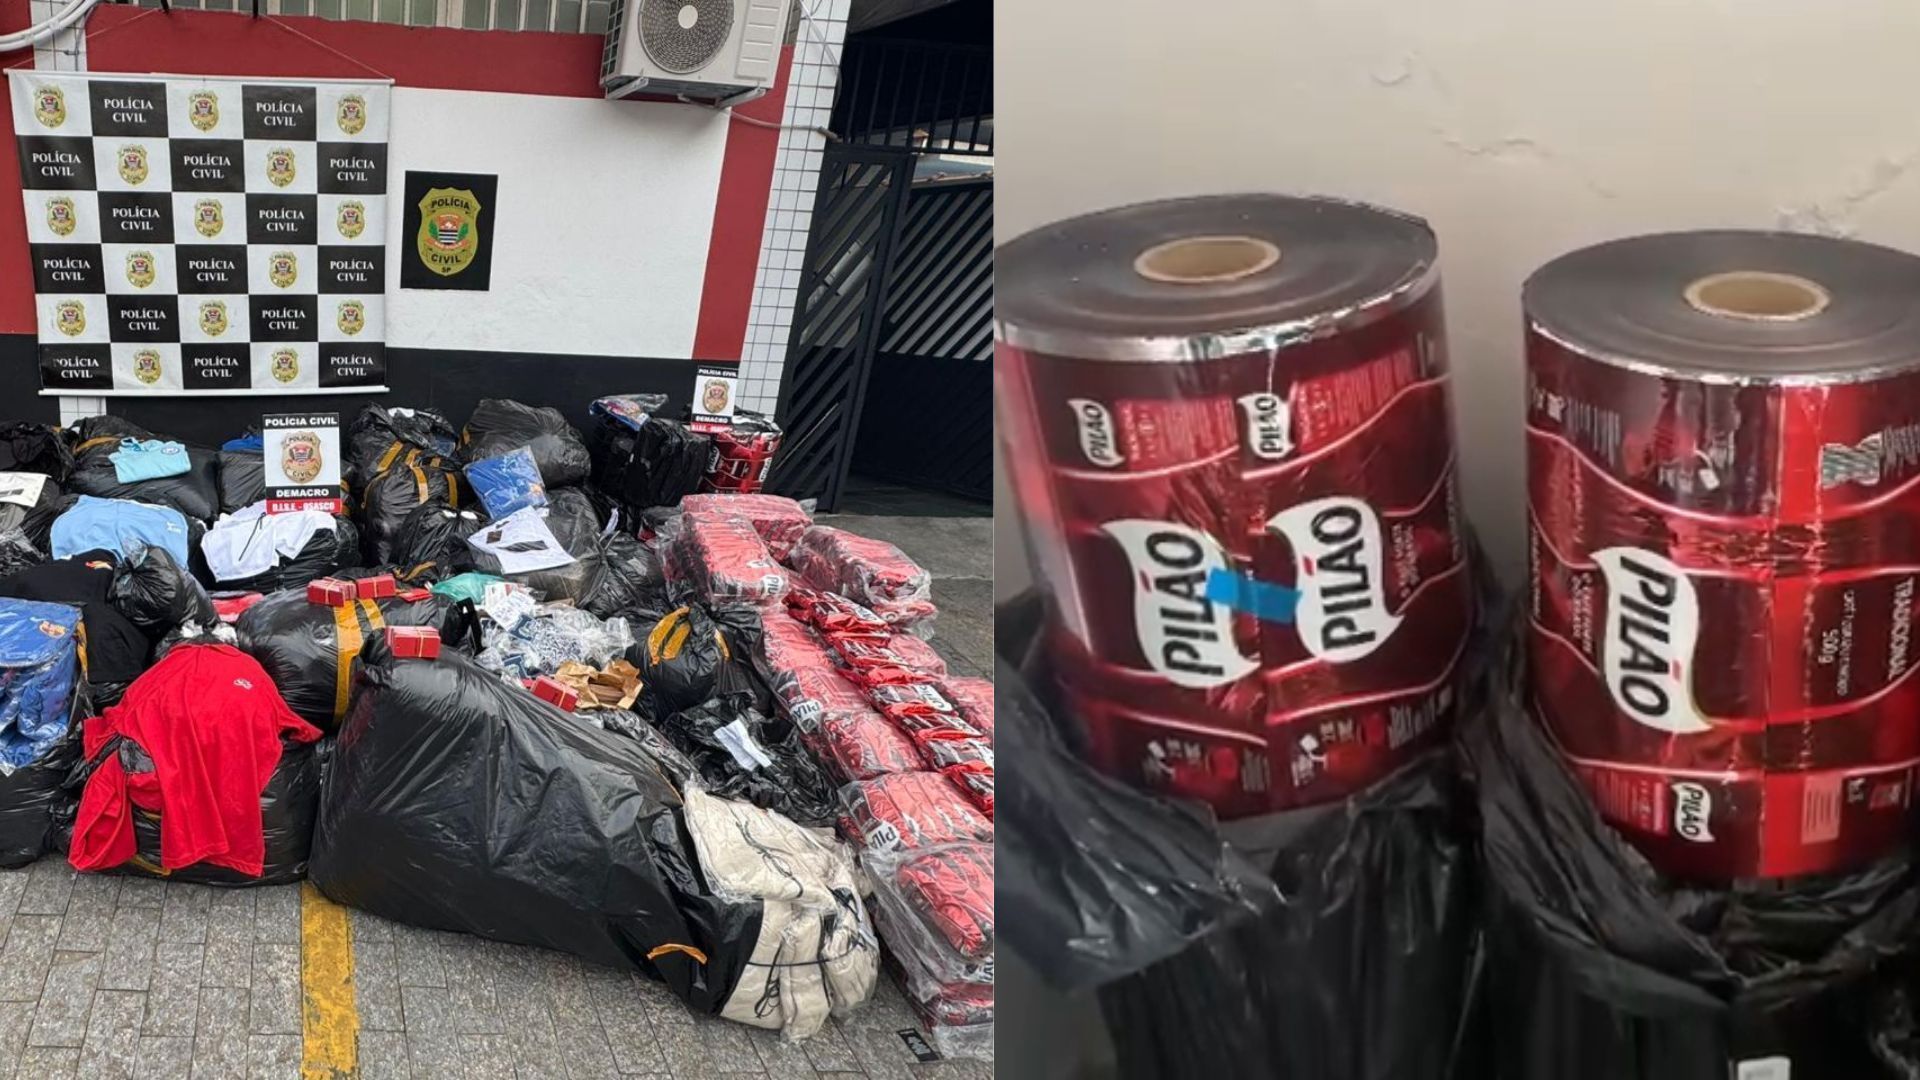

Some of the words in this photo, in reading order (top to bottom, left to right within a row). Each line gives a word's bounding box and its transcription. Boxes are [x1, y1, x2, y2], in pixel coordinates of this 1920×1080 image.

[104, 97, 154, 110] POLÍCIA
[256, 102, 303, 113] POLÍCIA
[112, 113, 146, 123] CIVIL
[263, 116, 296, 127] CIVIL
[32, 150, 81, 164] POLÍCIA
[183, 153, 231, 166] POLÍCIA
[330, 158, 375, 169] POLÍCIA
[41, 167, 74, 177] CIVIL
[191, 169, 224, 179] CIVIL
[336, 172, 368, 182] CIVIL
[431, 197, 470, 210] POLÍCIA
[112, 207, 160, 218] POLÍCIA
[259, 207, 305, 220] POLÍCIA
[120, 221, 153, 230] CIVIL
[266, 223, 298, 232] CIVIL
[43, 258, 91, 269] POLÍCIA
[189, 258, 235, 270] POLÍCIA
[431, 254, 461, 264] CIVIL
[330, 260, 374, 270] POLÍCIA
[51, 272, 85, 281] CIVIL
[196, 273, 228, 282] CIVIL
[336, 273, 367, 282] CIVIL
[120, 308, 166, 319] POLÍCIA
[262, 307, 306, 319] POLÍCIA
[128, 322, 160, 331] CIVIL
[268, 321, 299, 330] CIVIL
[194, 356, 239, 367] POLÍCIA
[330, 356, 374, 365] POLÍCIA
[60, 370, 93, 378] CIVIL
[201, 369, 232, 378] CIVIL
[337, 368, 367, 376] CIVIL
[265, 417, 307, 427] POLÍCIA
[309, 417, 337, 426] CIVIL
[276, 488, 329, 498] DEMACRO
[303, 501, 335, 511] OSASCO
